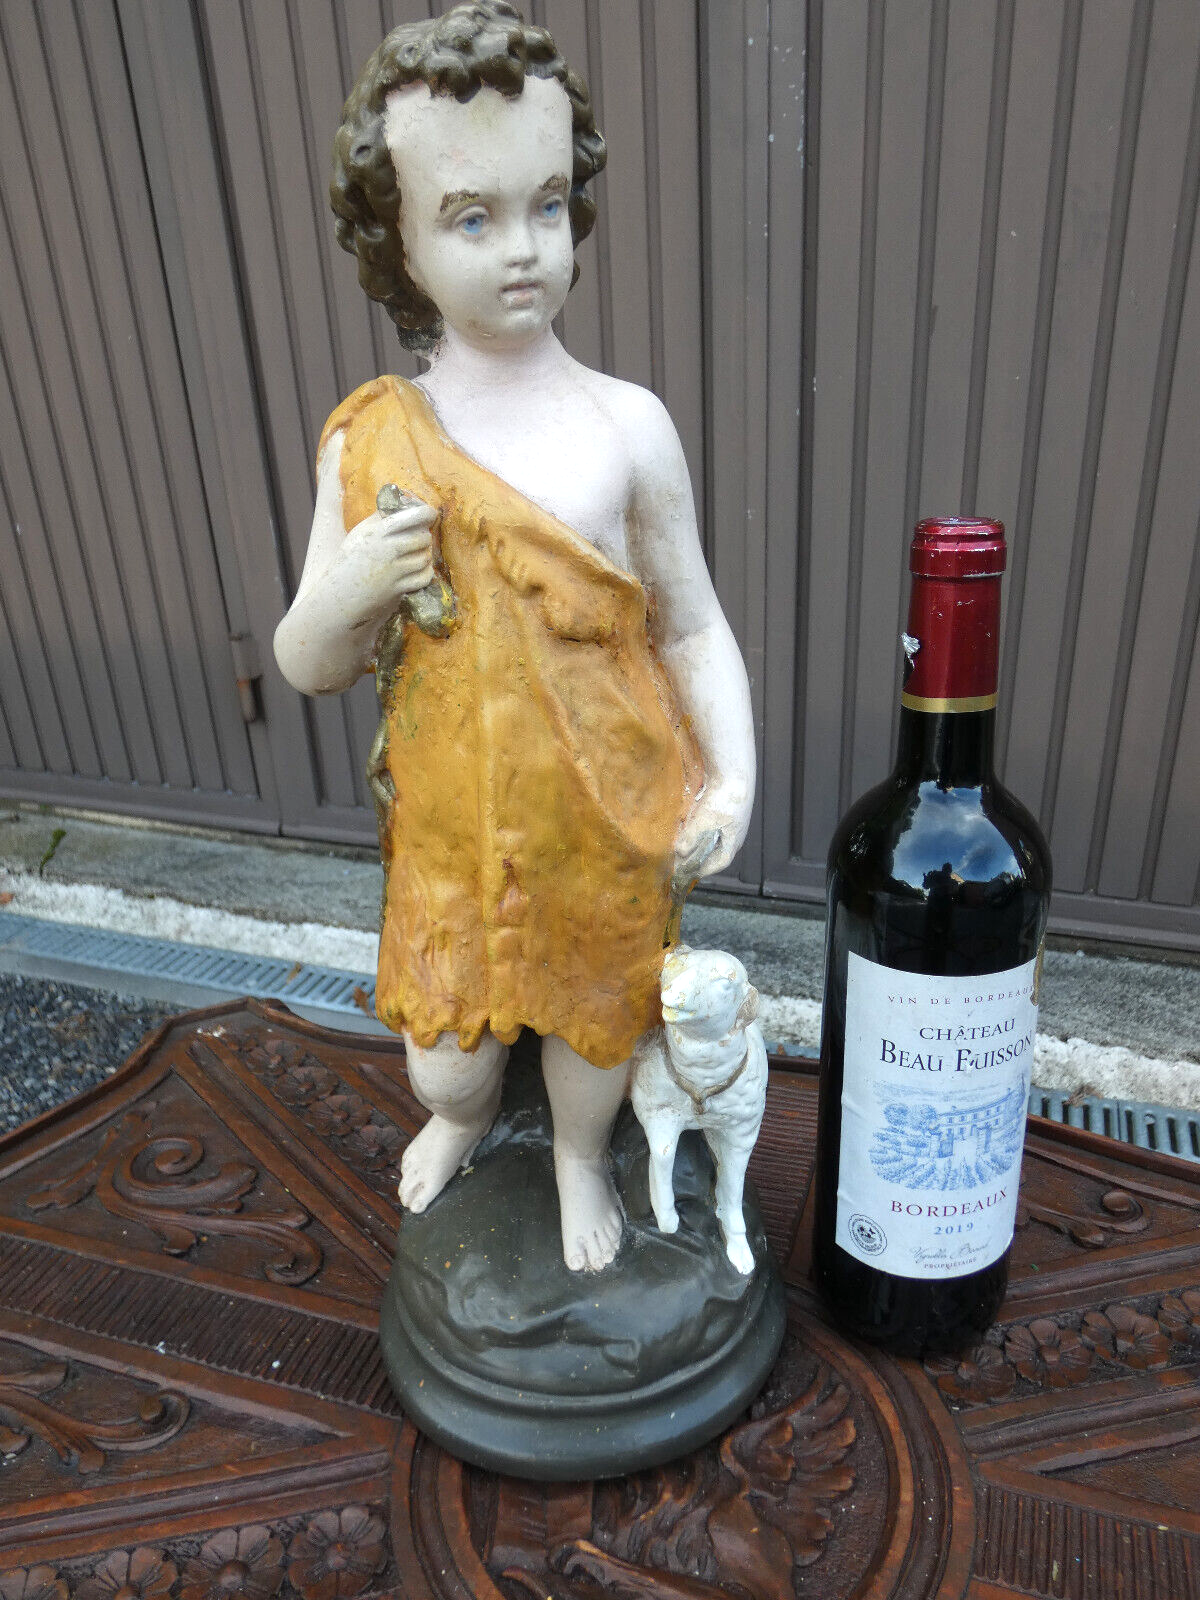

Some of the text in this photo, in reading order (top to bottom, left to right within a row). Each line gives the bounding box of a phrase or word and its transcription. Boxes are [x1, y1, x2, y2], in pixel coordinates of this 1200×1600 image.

[887, 995, 917, 1005] VIN
[919, 1018, 1016, 1041] CHÂTEAU
[879, 1037, 943, 1072] BEAU
[891, 1187, 1007, 1217] BORDEAUX
[934, 1222, 973, 1236] 2019
